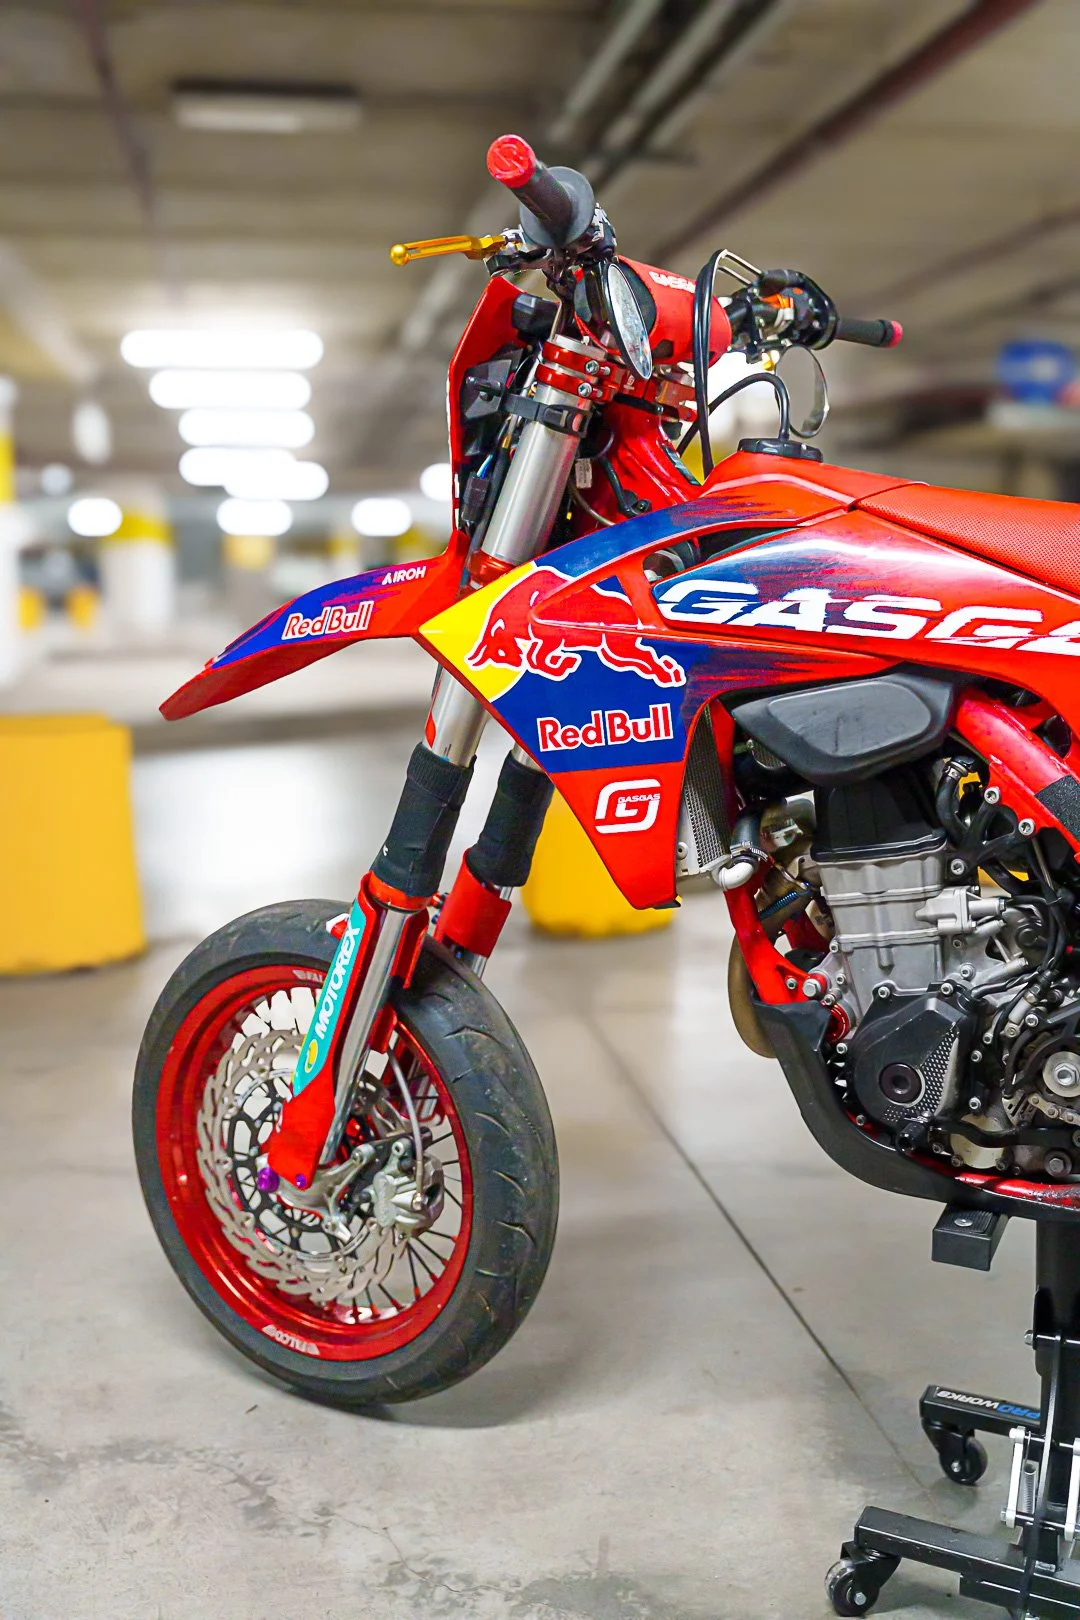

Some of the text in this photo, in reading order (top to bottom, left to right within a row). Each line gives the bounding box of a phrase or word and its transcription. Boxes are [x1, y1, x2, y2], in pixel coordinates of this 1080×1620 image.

[381, 566, 427, 585] AIROH
[281, 600, 374, 640] Red Bull
[537, 703, 673, 752] Red Bull
[617, 793, 661, 804] GASGAS
[315, 927, 360, 1040] MOTOREX
